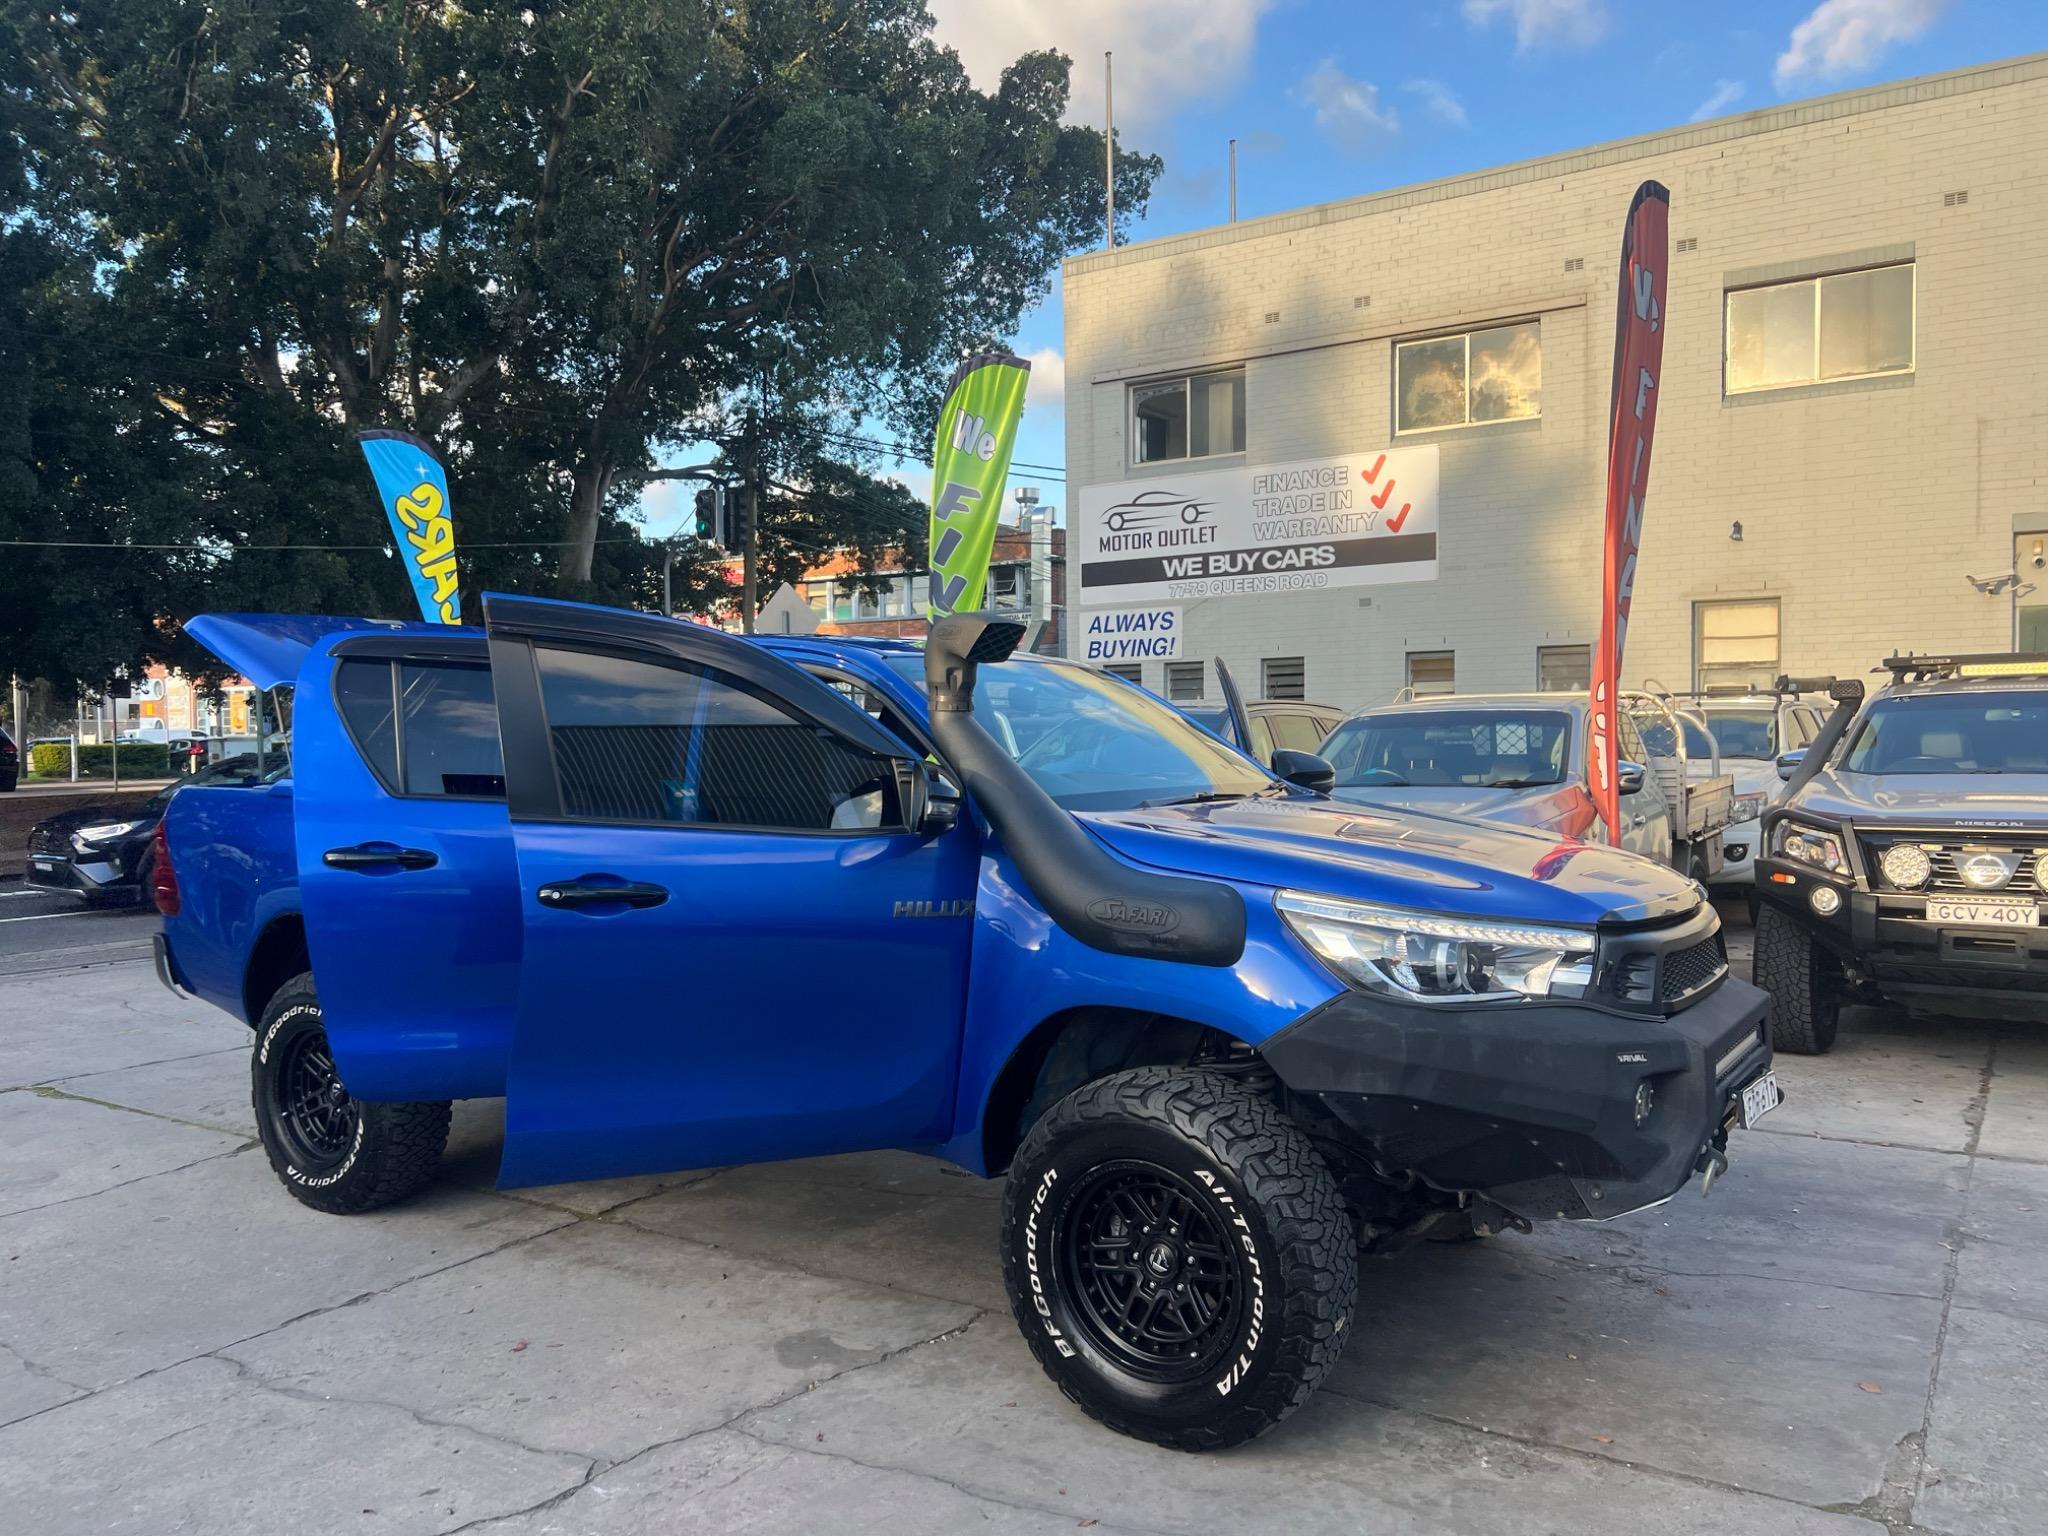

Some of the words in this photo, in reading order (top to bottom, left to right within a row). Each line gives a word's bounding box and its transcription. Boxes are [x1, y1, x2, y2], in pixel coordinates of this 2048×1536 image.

[952, 408, 997, 462] We
[1253, 466, 1348, 495] FINANCE
[1253, 492, 1326, 518] TRADE
[1329, 490, 1353, 510] IN
[1099, 531, 1153, 553] MOTOR
[1158, 525, 1218, 547] OUTLET
[1254, 511, 1378, 541] WARRANTY
[1162, 554, 1204, 578] WE
[1208, 550, 1262, 575] BUY
[1262, 545, 1336, 570] CARS
[1168, 580, 1207, 598] 77-79
[1211, 576, 1277, 595] QUEENS
[1278, 572, 1328, 590] ROAD
[1088, 611, 1175, 634] ALWAYS
[1088, 637, 1176, 659] BUYING!
[893, 899, 975, 919] HILUX
[1095, 899, 1170, 927] SAFARI
[1025, 1168, 1077, 1358] BFGoodrich
[1193, 1168, 1263, 1351] All-Terrain
[1216, 1353, 1252, 1396] T/A
